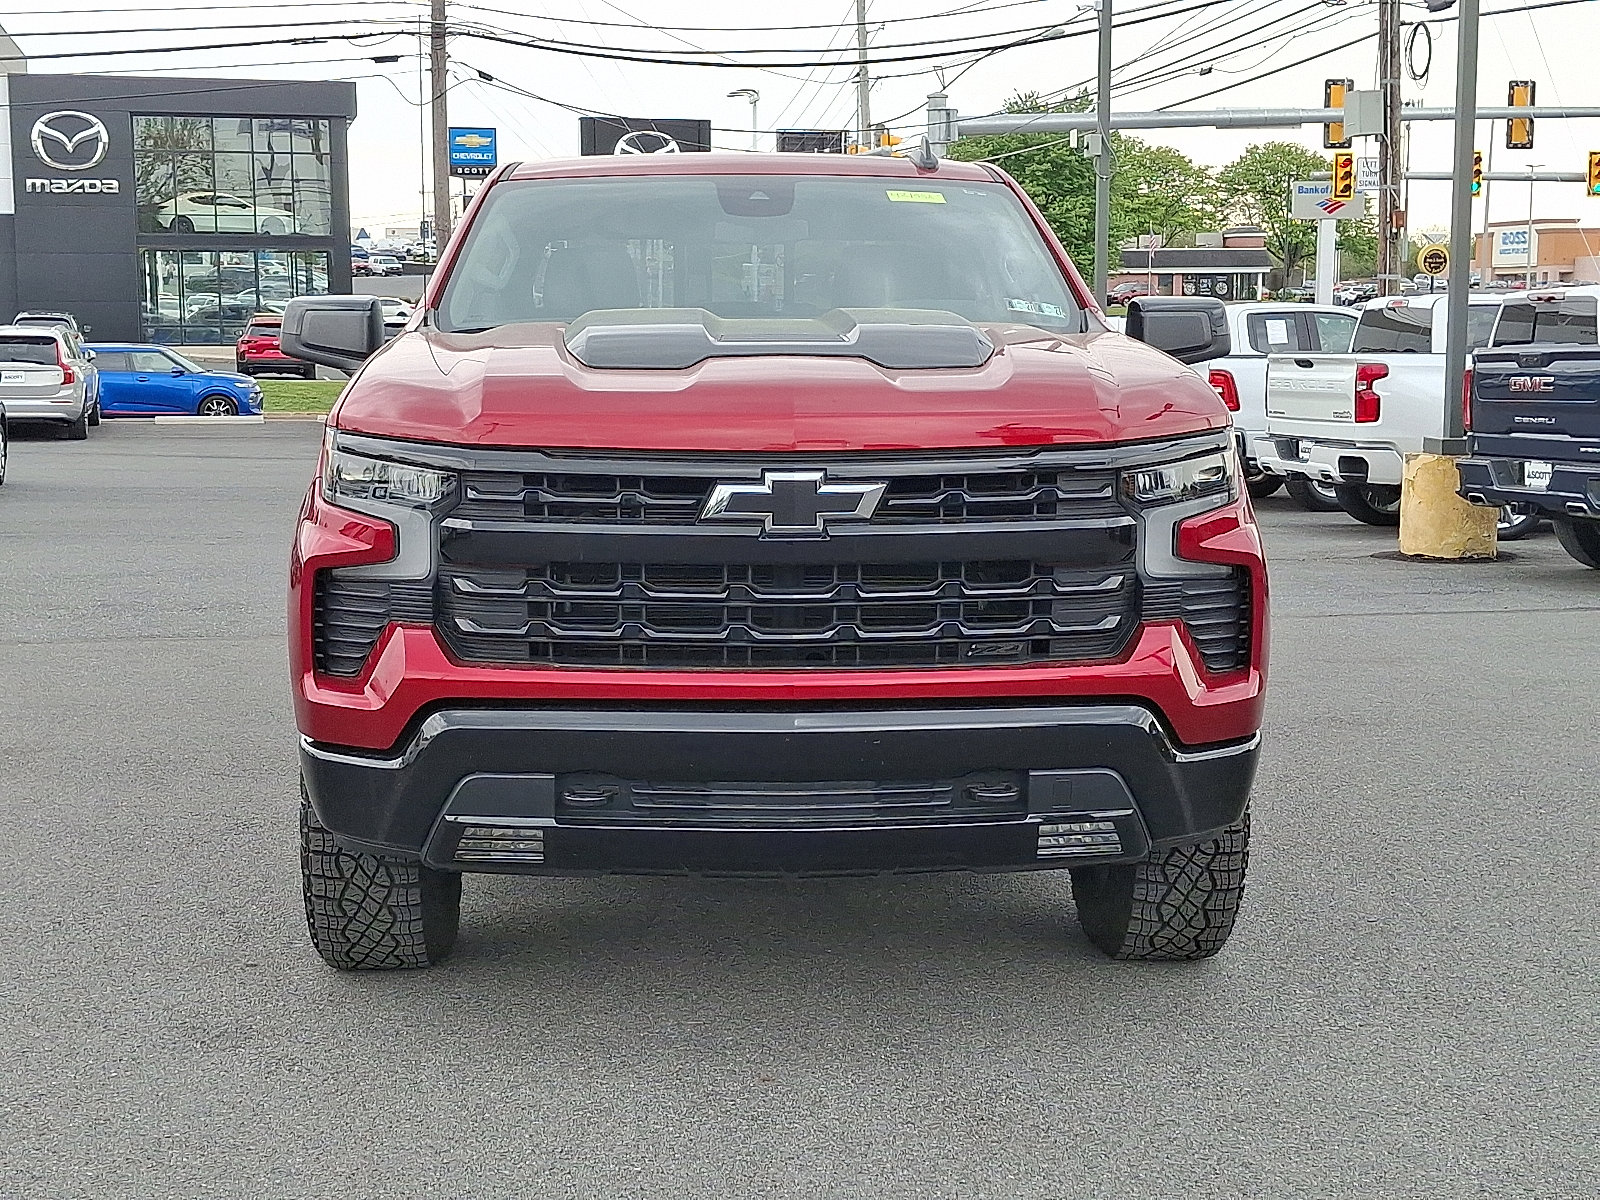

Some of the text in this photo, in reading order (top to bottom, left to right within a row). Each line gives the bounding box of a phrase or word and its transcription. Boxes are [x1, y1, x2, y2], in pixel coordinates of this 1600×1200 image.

[1362, 170, 1378, 178] TURN
[25, 178, 120, 194] mazda
[1358, 180, 1379, 188] SIGNAL
[1297, 185, 1319, 195] Bank
[1320, 185, 1330, 195] of
[1509, 376, 1555, 392] GMC
[1514, 416, 1556, 424] DENALI
